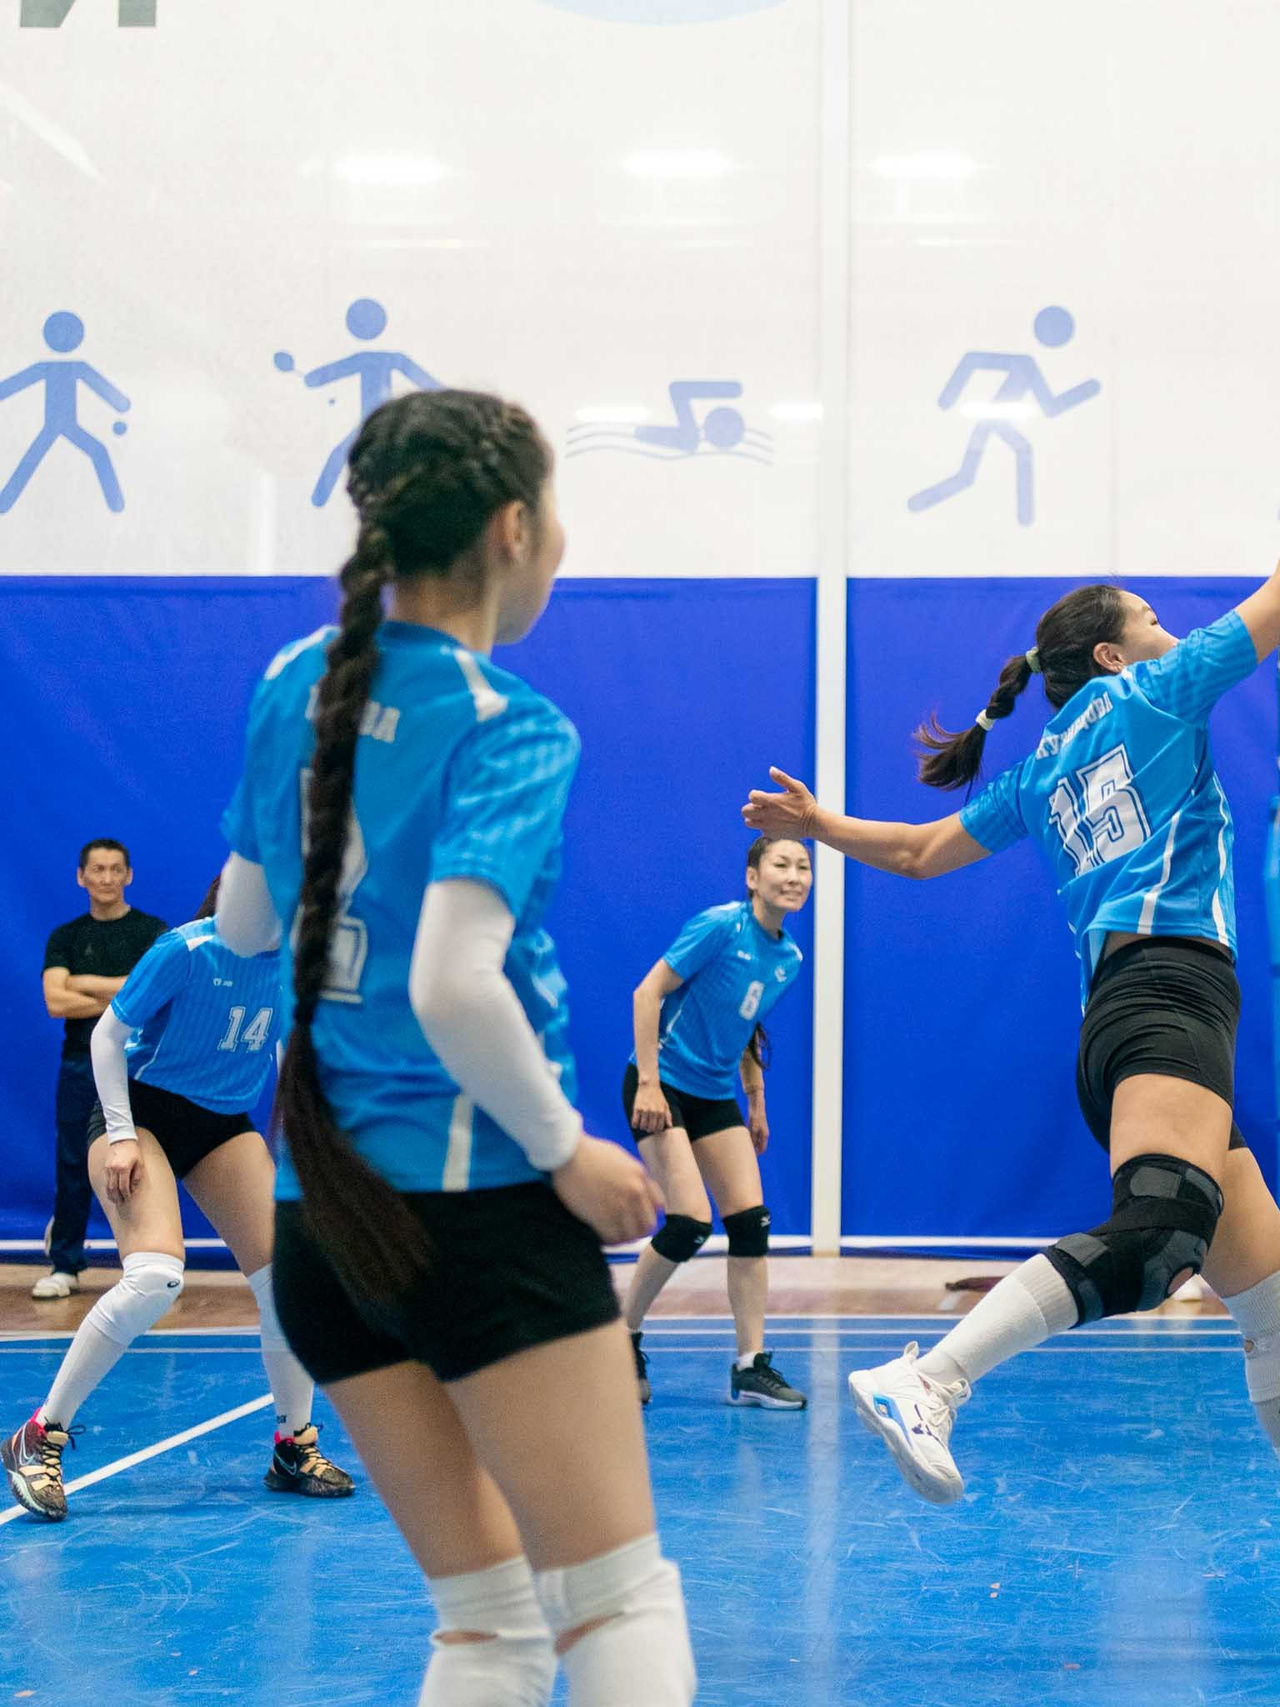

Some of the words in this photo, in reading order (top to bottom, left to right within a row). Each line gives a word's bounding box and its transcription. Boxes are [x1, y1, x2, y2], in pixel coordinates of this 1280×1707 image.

[1049, 743, 1151, 879] 15
[739, 980, 765, 1021] 6
[217, 1005, 274, 1054] 14
